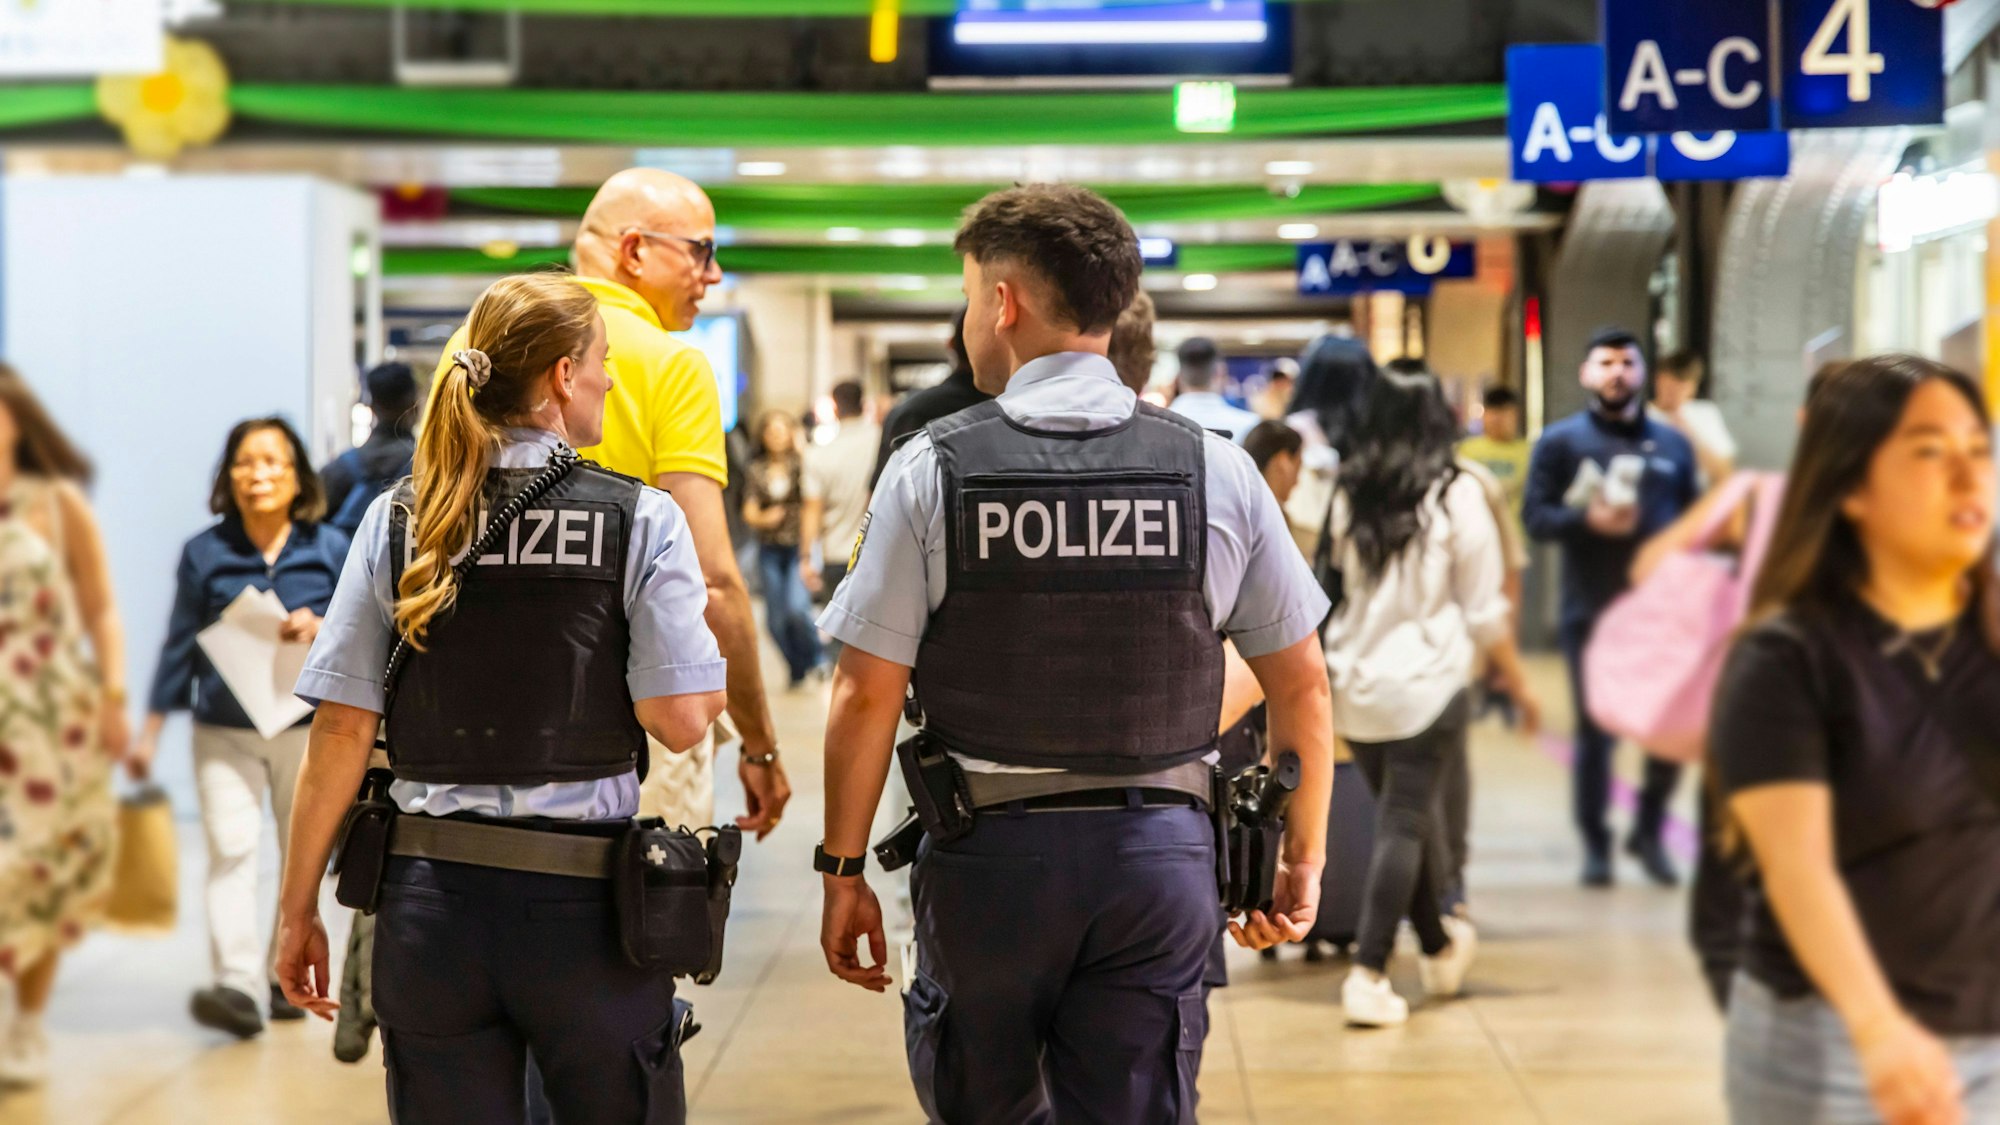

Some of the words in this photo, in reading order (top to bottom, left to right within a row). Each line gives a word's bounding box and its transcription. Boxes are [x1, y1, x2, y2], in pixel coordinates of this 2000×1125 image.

[1619, 37, 1762, 111] A-C
[1801, 0, 1885, 102] 4
[977, 499, 1179, 560] POLIZEI
